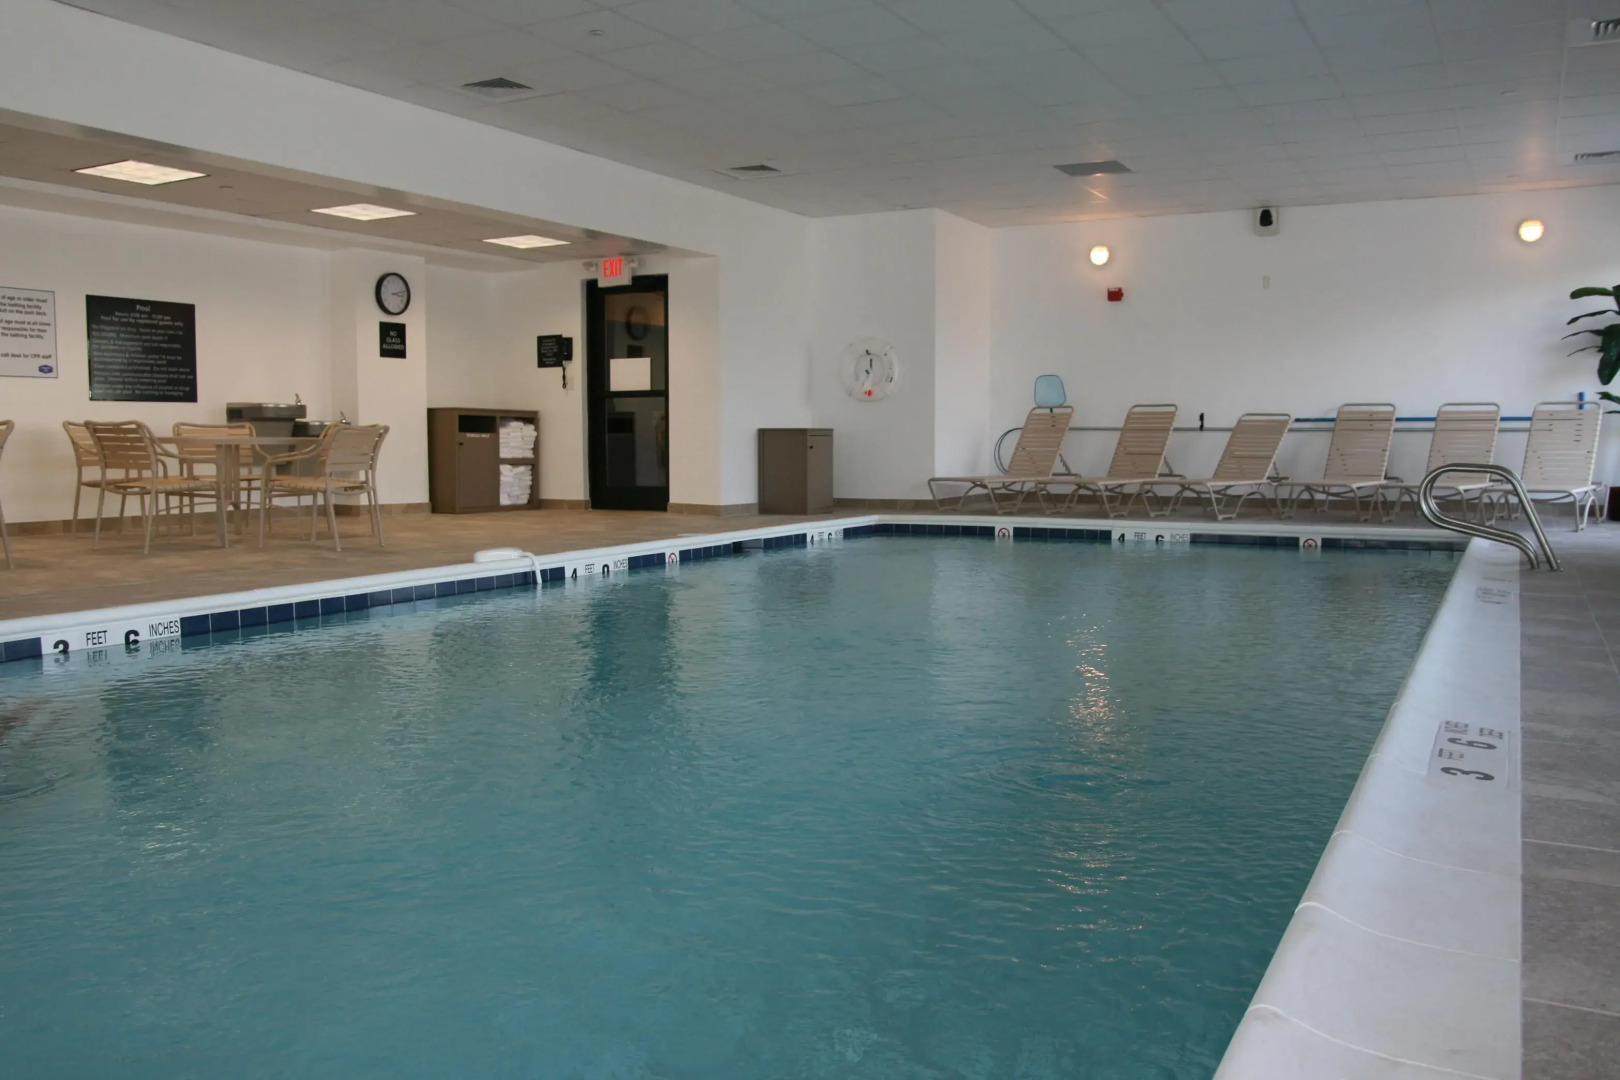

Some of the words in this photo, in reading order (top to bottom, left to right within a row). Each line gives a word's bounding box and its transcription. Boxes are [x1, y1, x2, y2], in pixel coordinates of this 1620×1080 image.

[603, 258, 623, 278] EXIT
[136, 304, 151, 312] Pool
[585, 563, 596, 574] FEET
[613, 559, 628, 570] INCHES
[86, 630, 108, 646] FEET
[149, 620, 180, 637] INCHES
[1447, 737, 1498, 750] 6
[1440, 766, 1496, 781] 3
